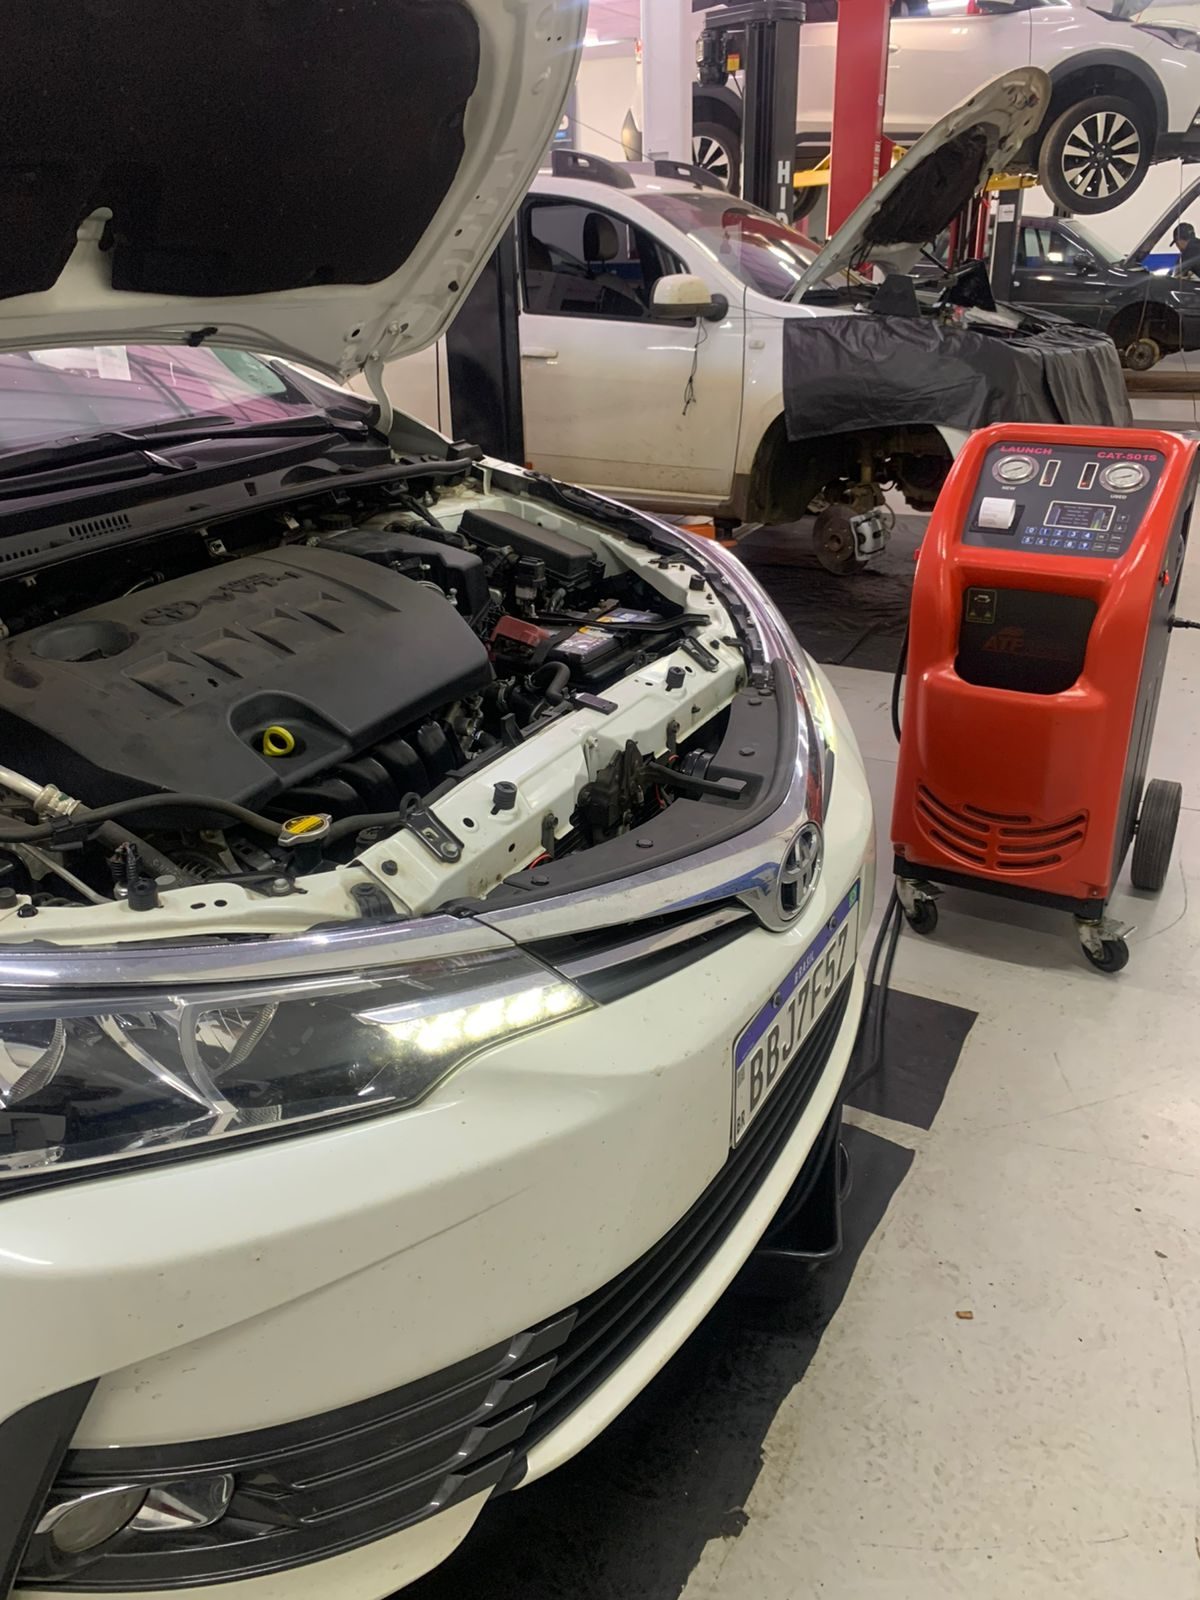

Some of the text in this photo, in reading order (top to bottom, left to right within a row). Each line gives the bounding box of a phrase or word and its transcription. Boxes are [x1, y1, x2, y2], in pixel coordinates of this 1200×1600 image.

[1000, 446, 1053, 455] LAUNCH
[1097, 451, 1157, 461] CAT-501S
[750, 921, 848, 1113] BBJ7F57
[736, 1110, 746, 1135] BR
